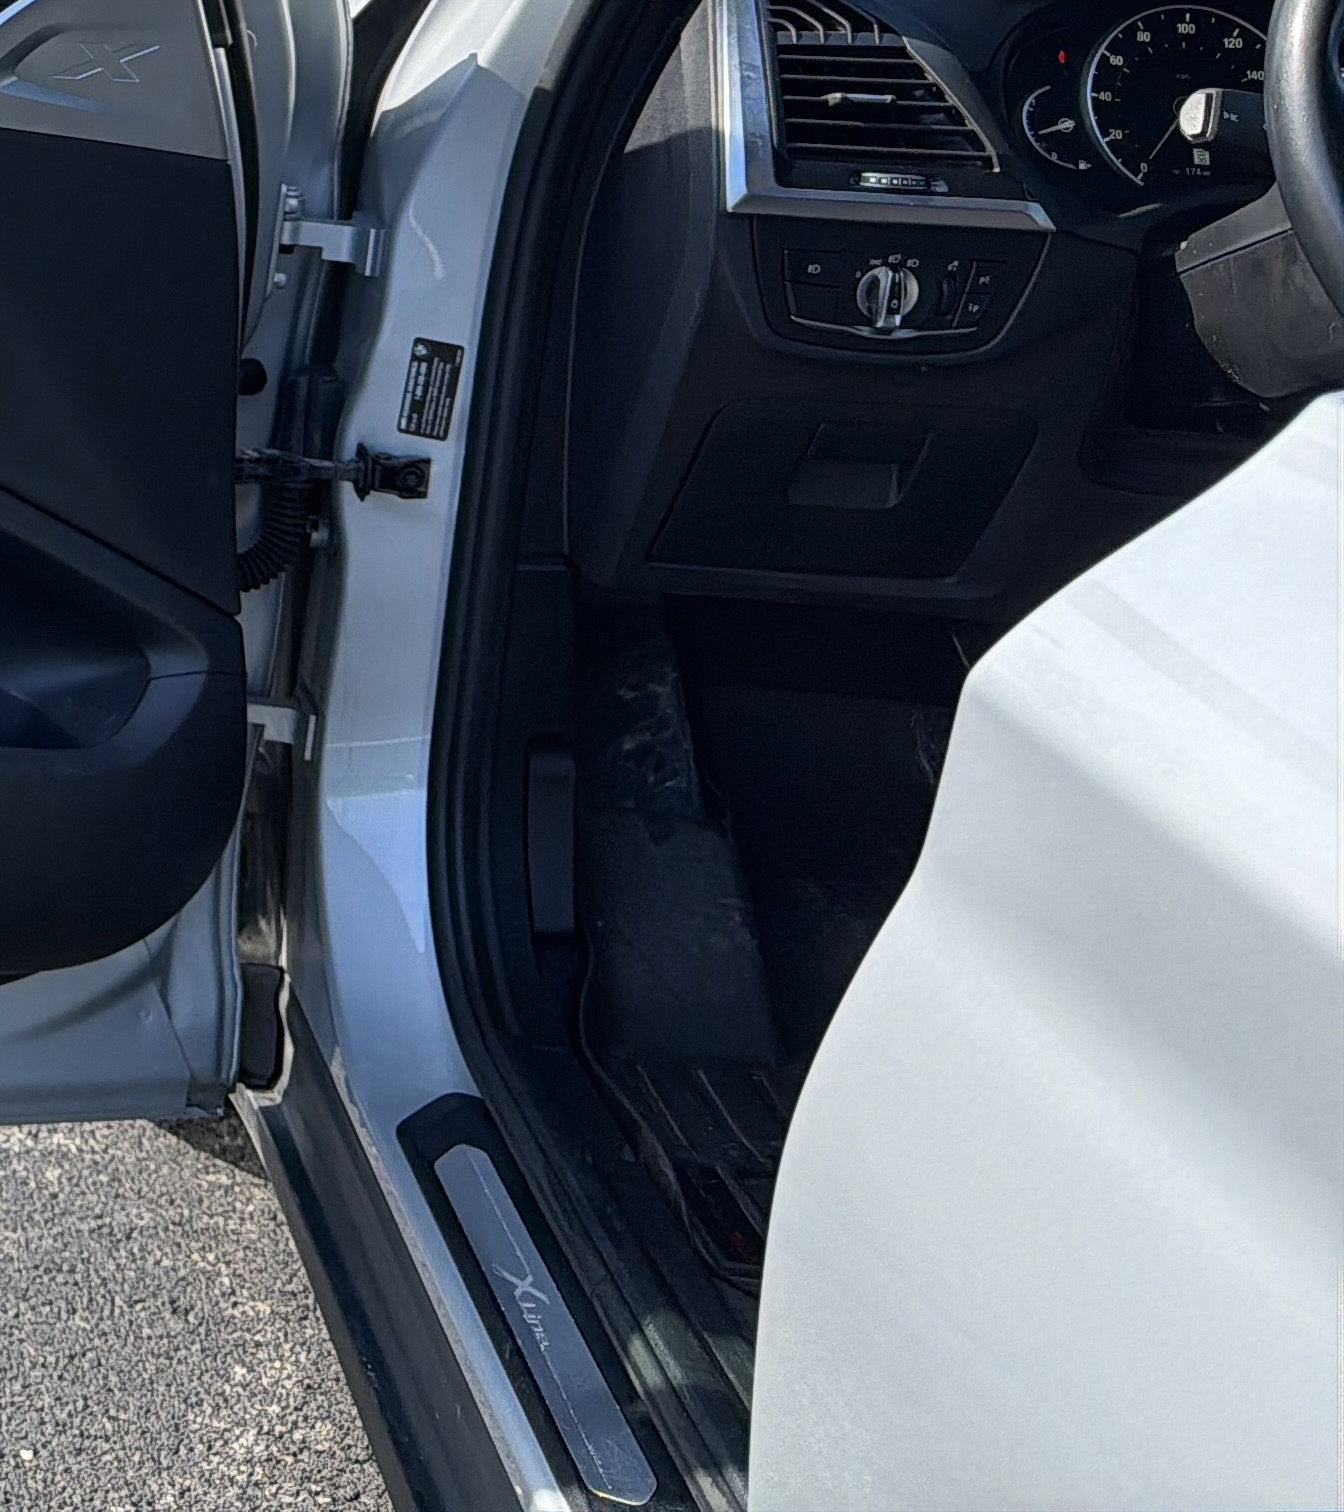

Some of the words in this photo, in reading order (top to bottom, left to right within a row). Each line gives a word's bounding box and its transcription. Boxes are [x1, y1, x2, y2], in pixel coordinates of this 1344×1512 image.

[1176, 23, 1196, 34] 100
[1136, 31, 1151, 42] 80
[1223, 38, 1243, 49] 120
[1109, 55, 1124, 66] 60
[1246, 70, 1265, 81] 140
[1098, 91, 1112, 102] 40
[1108, 128, 1123, 140] 20
[1140, 162, 1148, 173] 0
[1185, 167, 1202, 176] 174
